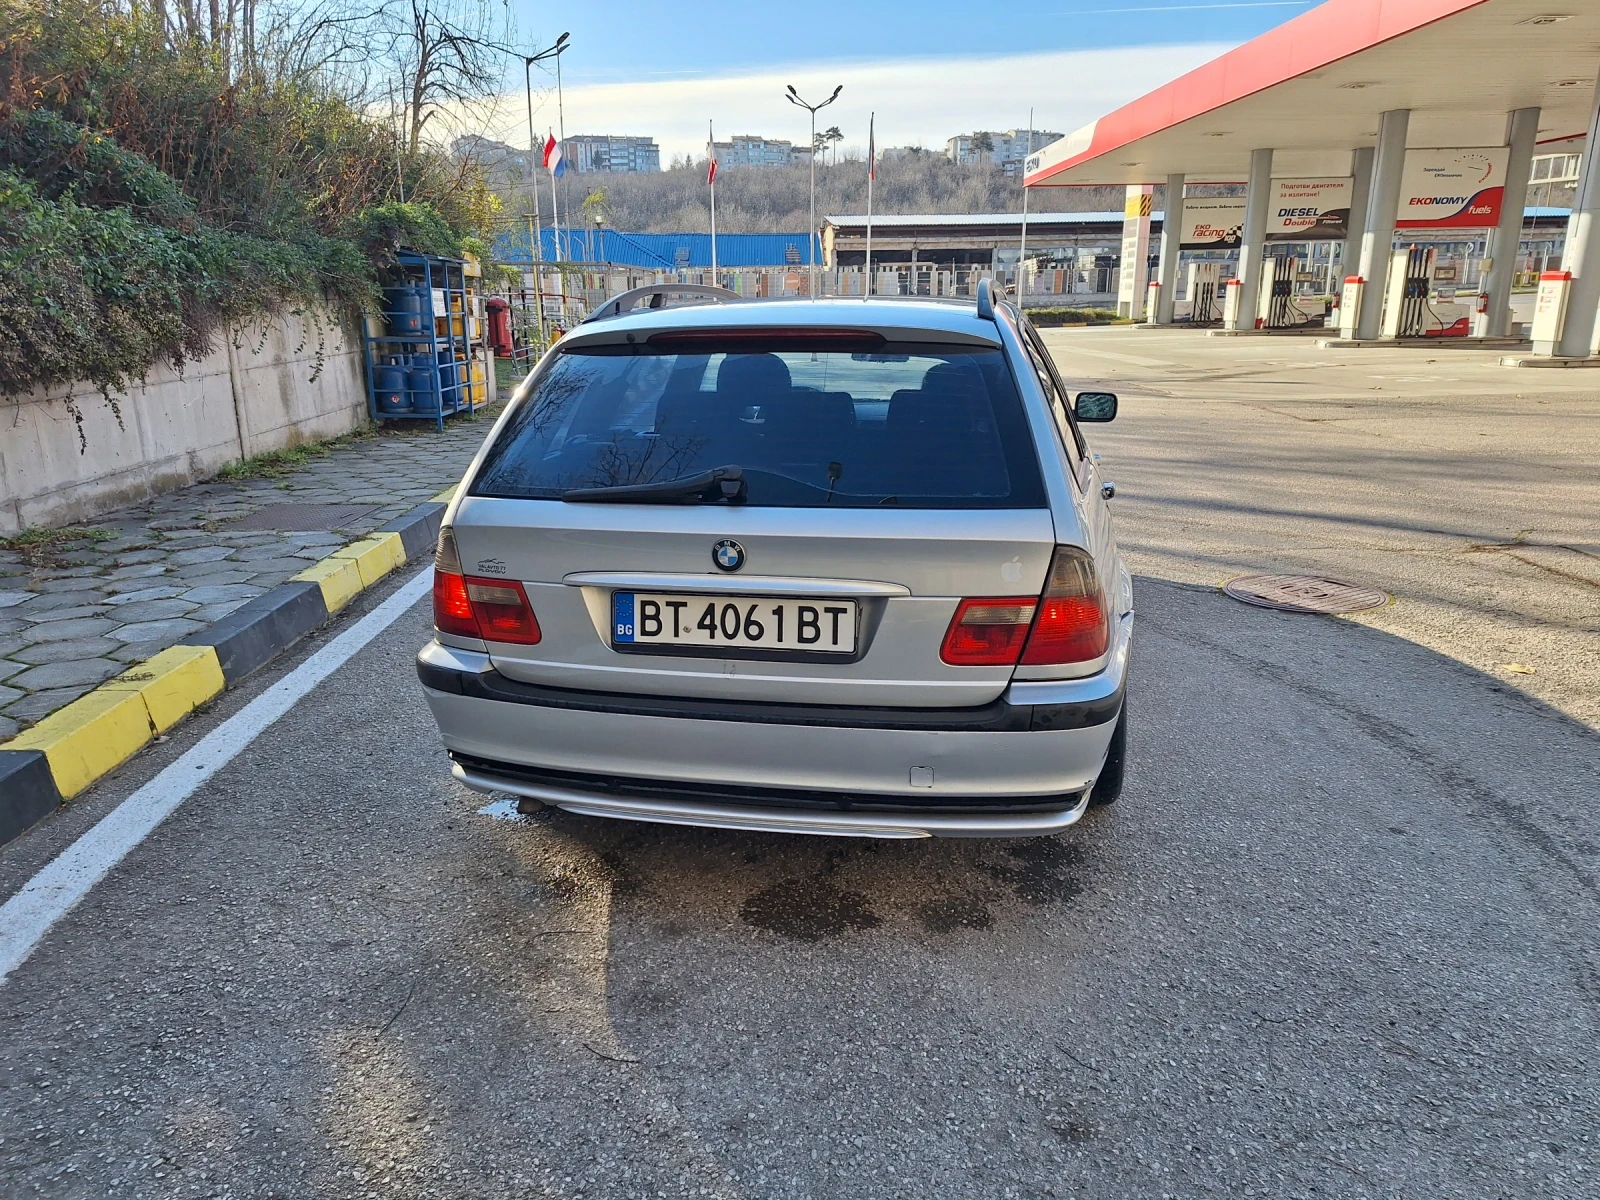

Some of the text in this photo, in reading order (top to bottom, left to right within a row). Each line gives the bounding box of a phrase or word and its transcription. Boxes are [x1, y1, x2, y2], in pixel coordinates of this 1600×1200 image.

[1408, 196, 1469, 206] EKONOMY
[1277, 207, 1319, 217] DIESEL
[1468, 205, 1493, 214] fuels
[1283, 218, 1316, 226] Double
[1192, 229, 1225, 239] racing
[640, 600, 848, 645] BT 4061 BT
[617, 624, 633, 635] BG
